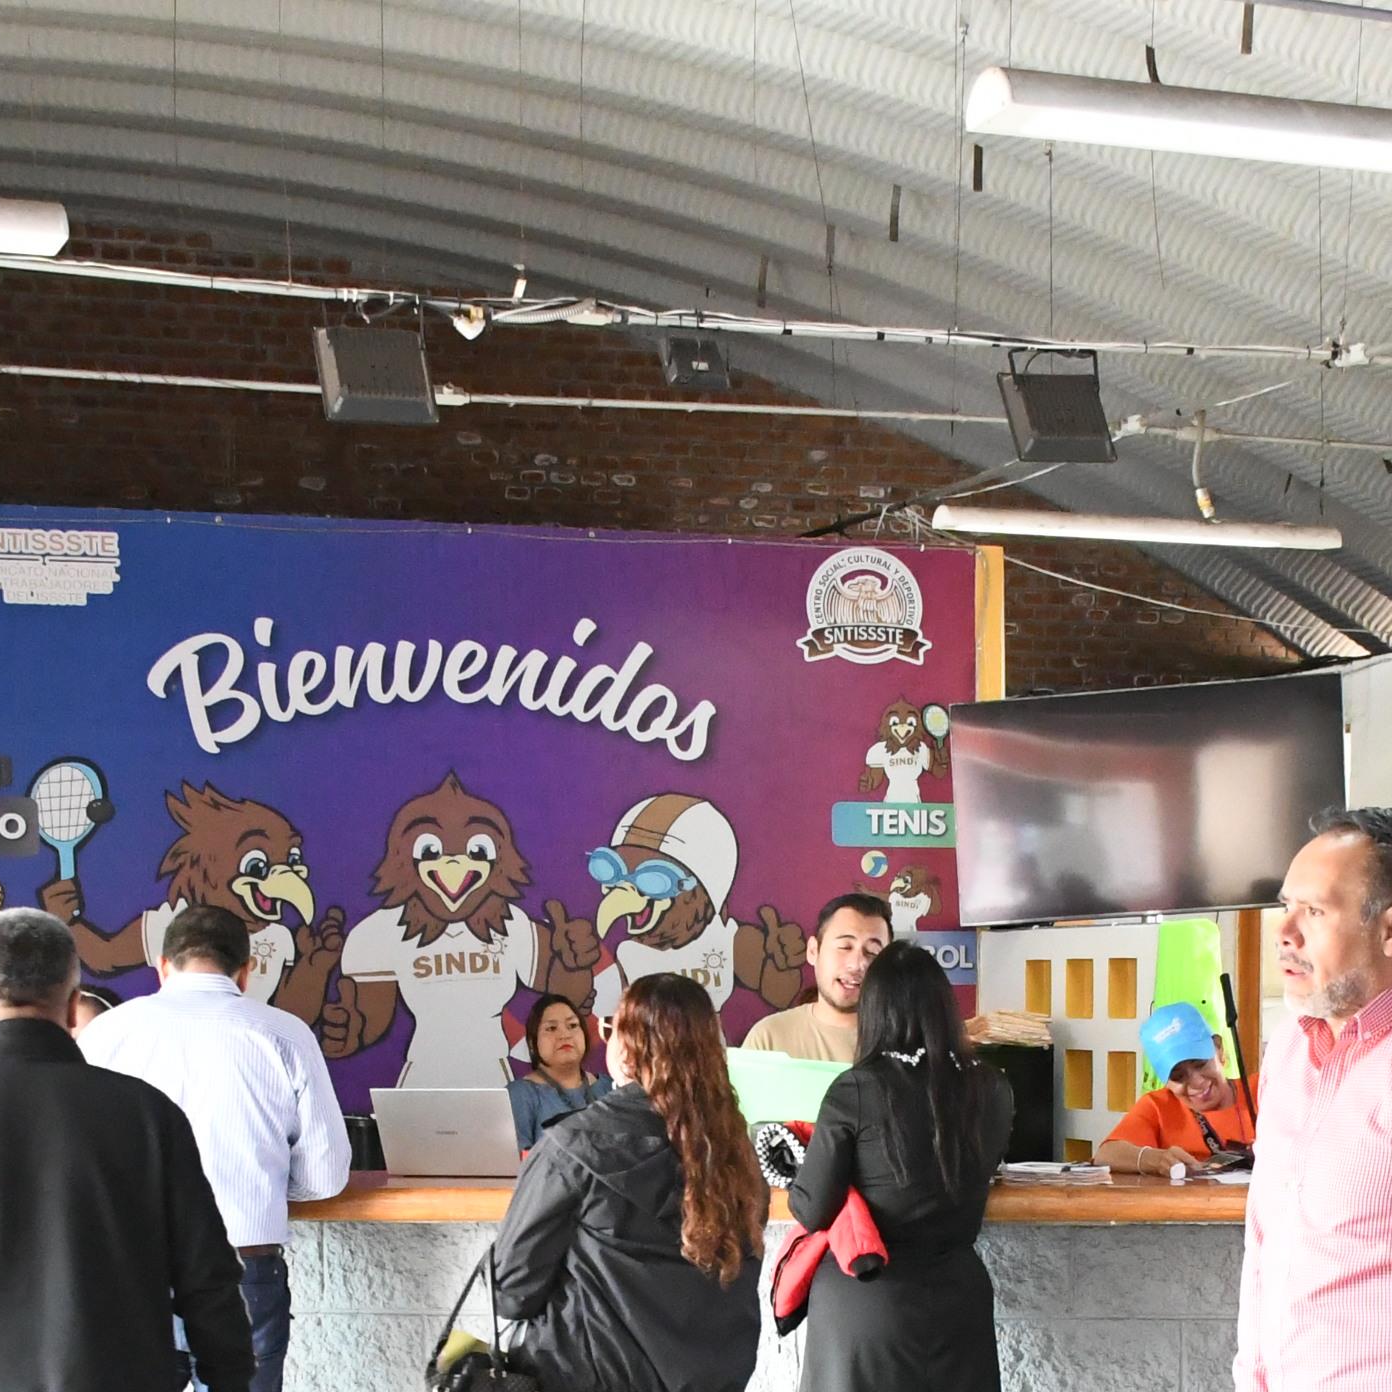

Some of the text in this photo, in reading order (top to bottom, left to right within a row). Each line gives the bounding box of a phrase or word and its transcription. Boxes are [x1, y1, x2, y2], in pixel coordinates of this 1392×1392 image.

[814, 588, 825, 625] CENTRO
[847, 554, 892, 571] CULTURAL
[898, 575, 916, 626] DEPORTIVO
[824, 626, 904, 645] SNTISSSTE
[146, 616, 718, 762] Bienvenidos
[865, 808, 948, 836] TENIS
